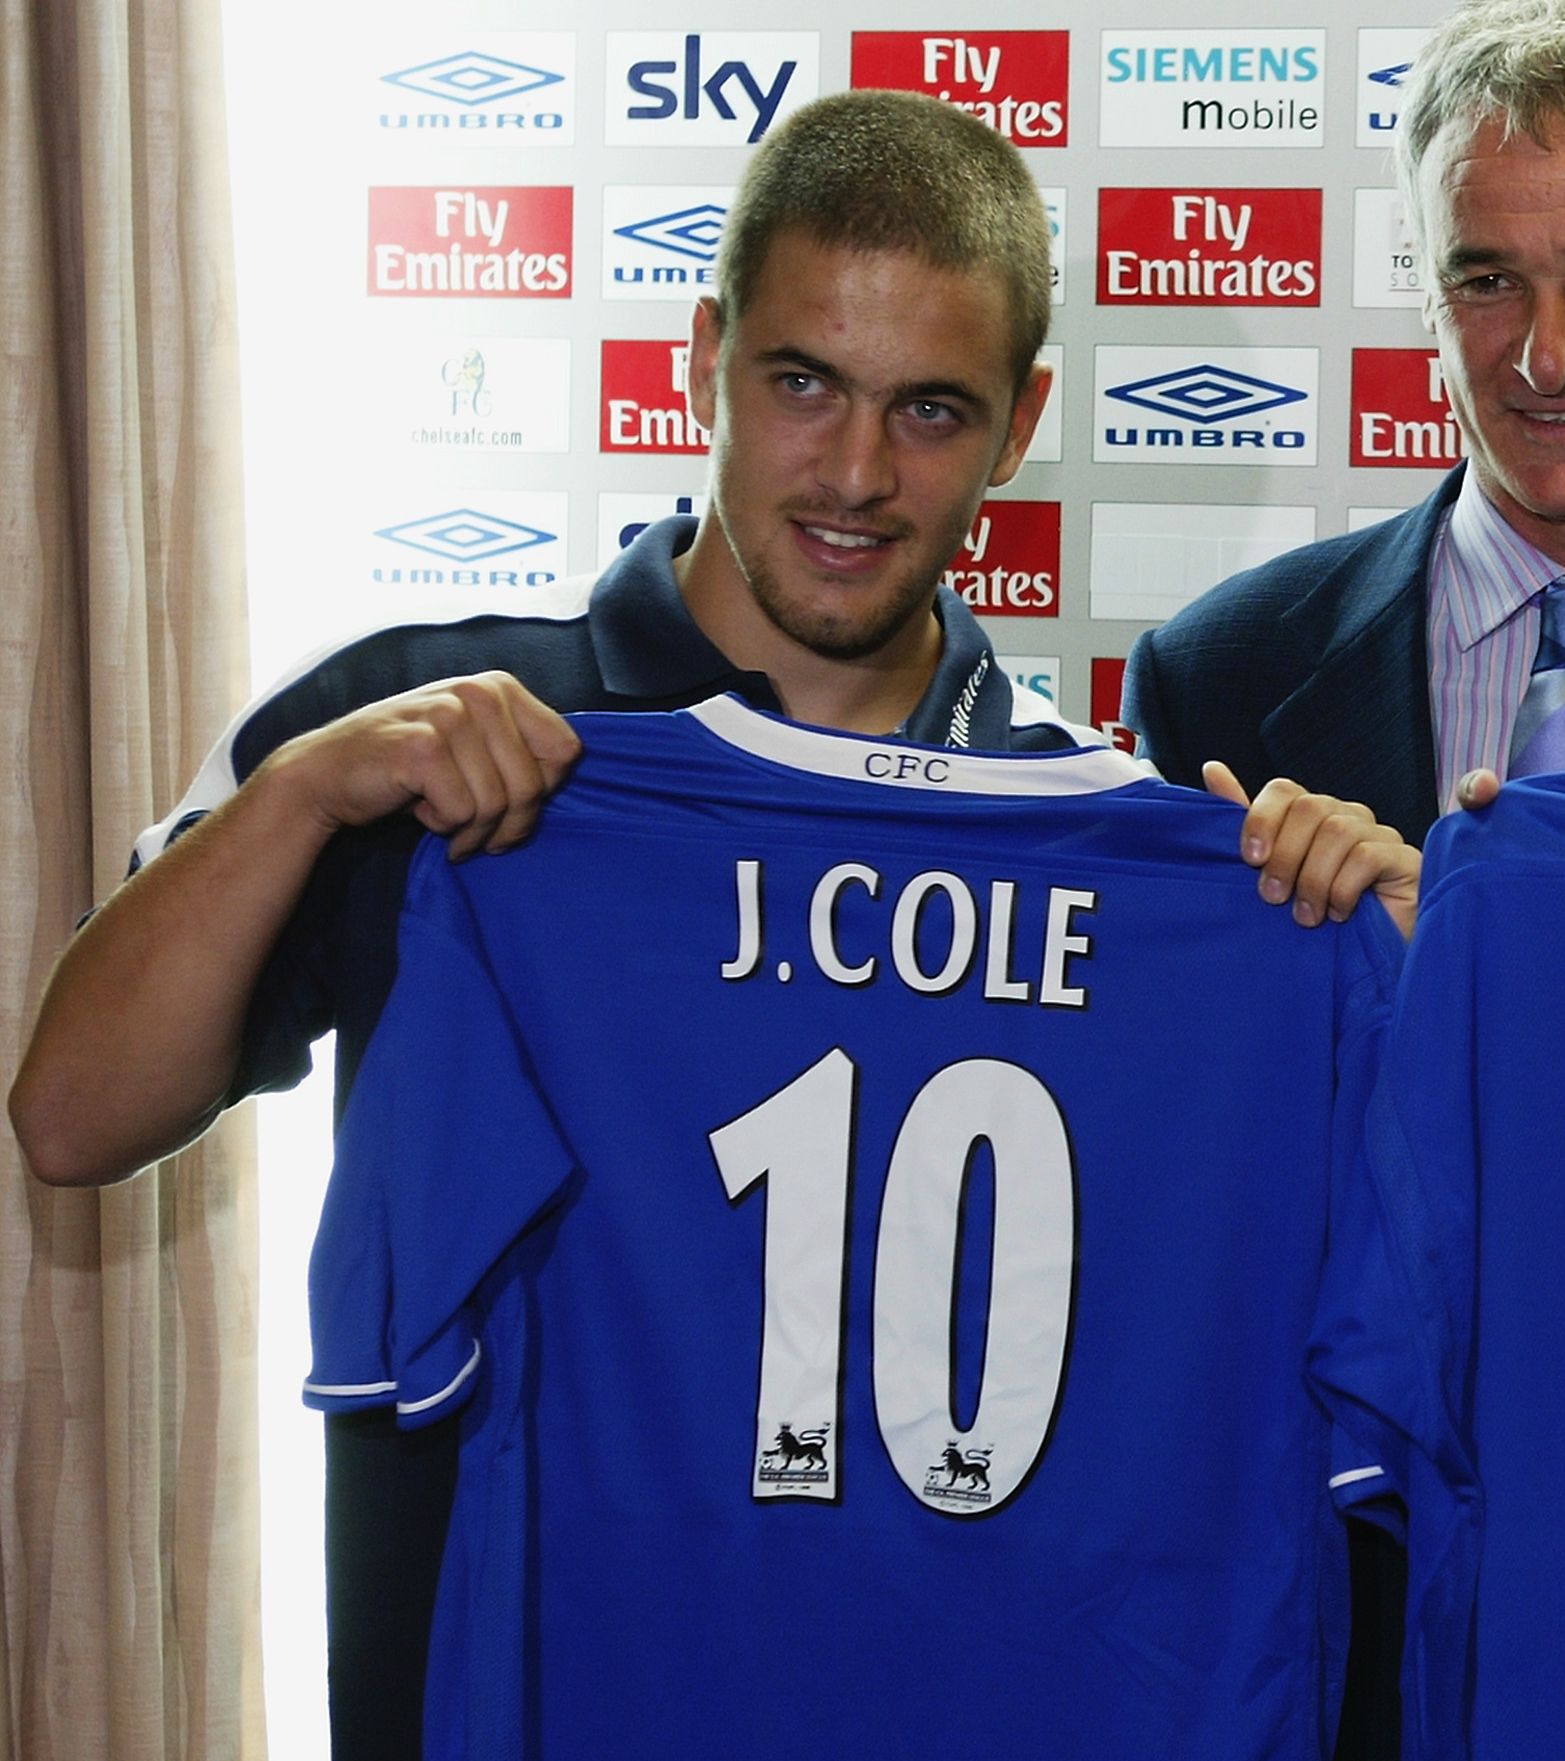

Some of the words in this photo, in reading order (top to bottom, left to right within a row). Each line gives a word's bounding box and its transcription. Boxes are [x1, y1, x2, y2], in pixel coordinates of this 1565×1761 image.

[627, 34, 798, 144] sky
[922, 38, 1001, 93] Fly
[1107, 46, 1318, 84] SIEMENS
[1182, 99, 1318, 130] mobile
[434, 192, 509, 247] Fly
[1172, 195, 1252, 251] Fly
[374, 246, 568, 292] Emirates
[1106, 250, 1315, 298] Emirates
[944, 565, 1053, 607] rates
[864, 752, 949, 783] CFC
[720, 859, 1097, 1008] J.COLE
[708, 1046, 1078, 1517] 10
